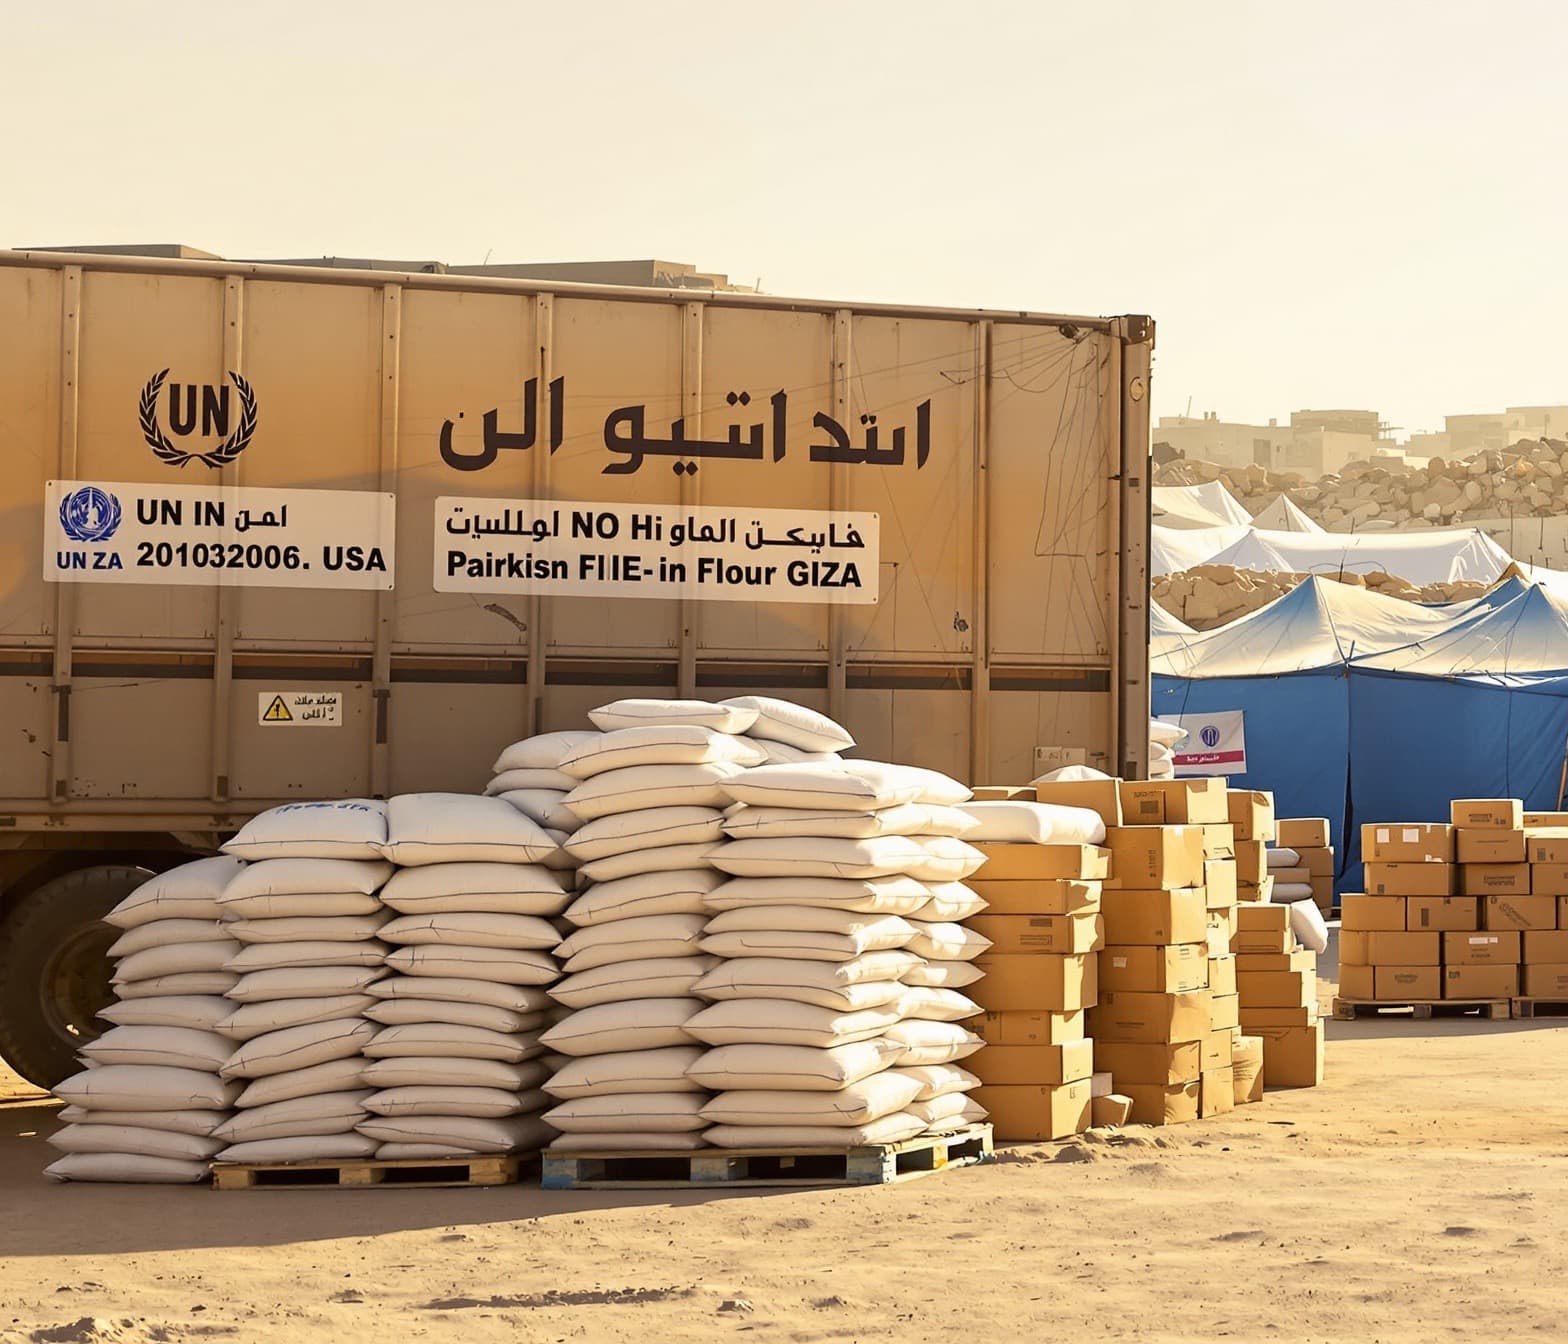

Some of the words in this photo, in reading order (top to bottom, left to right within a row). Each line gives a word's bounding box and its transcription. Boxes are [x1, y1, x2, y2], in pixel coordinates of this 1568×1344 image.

[169, 383, 230, 437] UN
[137, 499, 182, 526] UN
[194, 501, 225, 527] IN
[572, 511, 619, 539] NO
[631, 514, 662, 541] Hi
[57, 551, 87, 570] UN
[92, 551, 124, 570] ZA
[137, 541, 310, 570] 201032006.
[323, 546, 387, 572] USA
[447, 550, 568, 579] Pairkisn
[698, 557, 777, 586] Flour
[787, 560, 862, 588] GIZA
